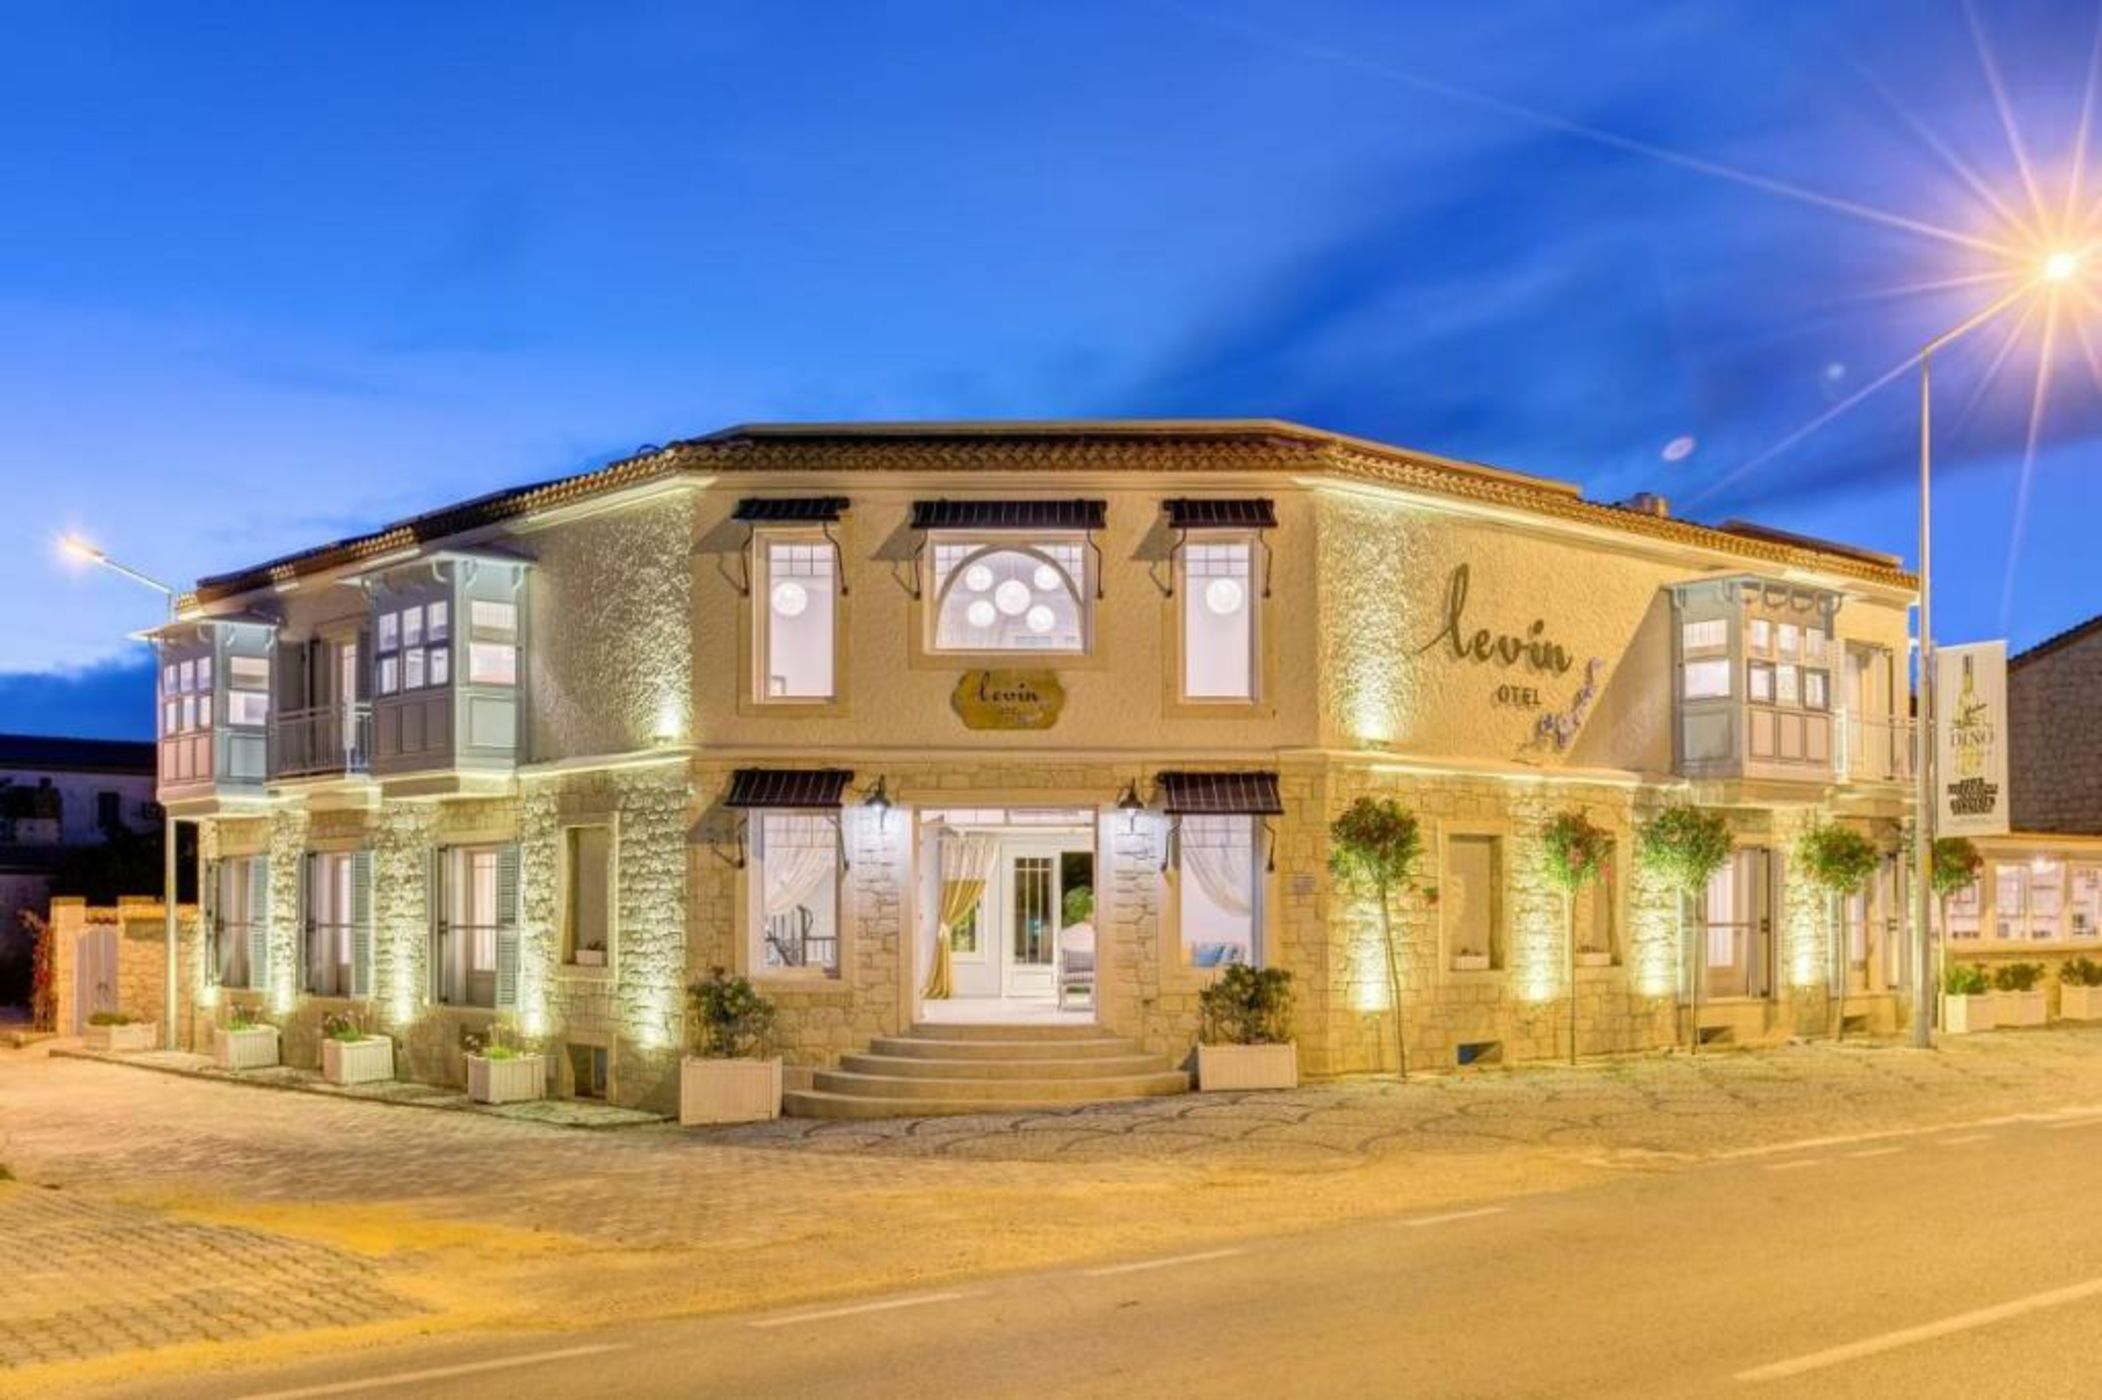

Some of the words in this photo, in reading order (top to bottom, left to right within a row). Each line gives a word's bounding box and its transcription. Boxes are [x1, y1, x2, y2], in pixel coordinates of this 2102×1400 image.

[1418, 563, 1574, 673] levin
[978, 670, 1040, 703] levin
[1497, 683, 1542, 706] OTEL
